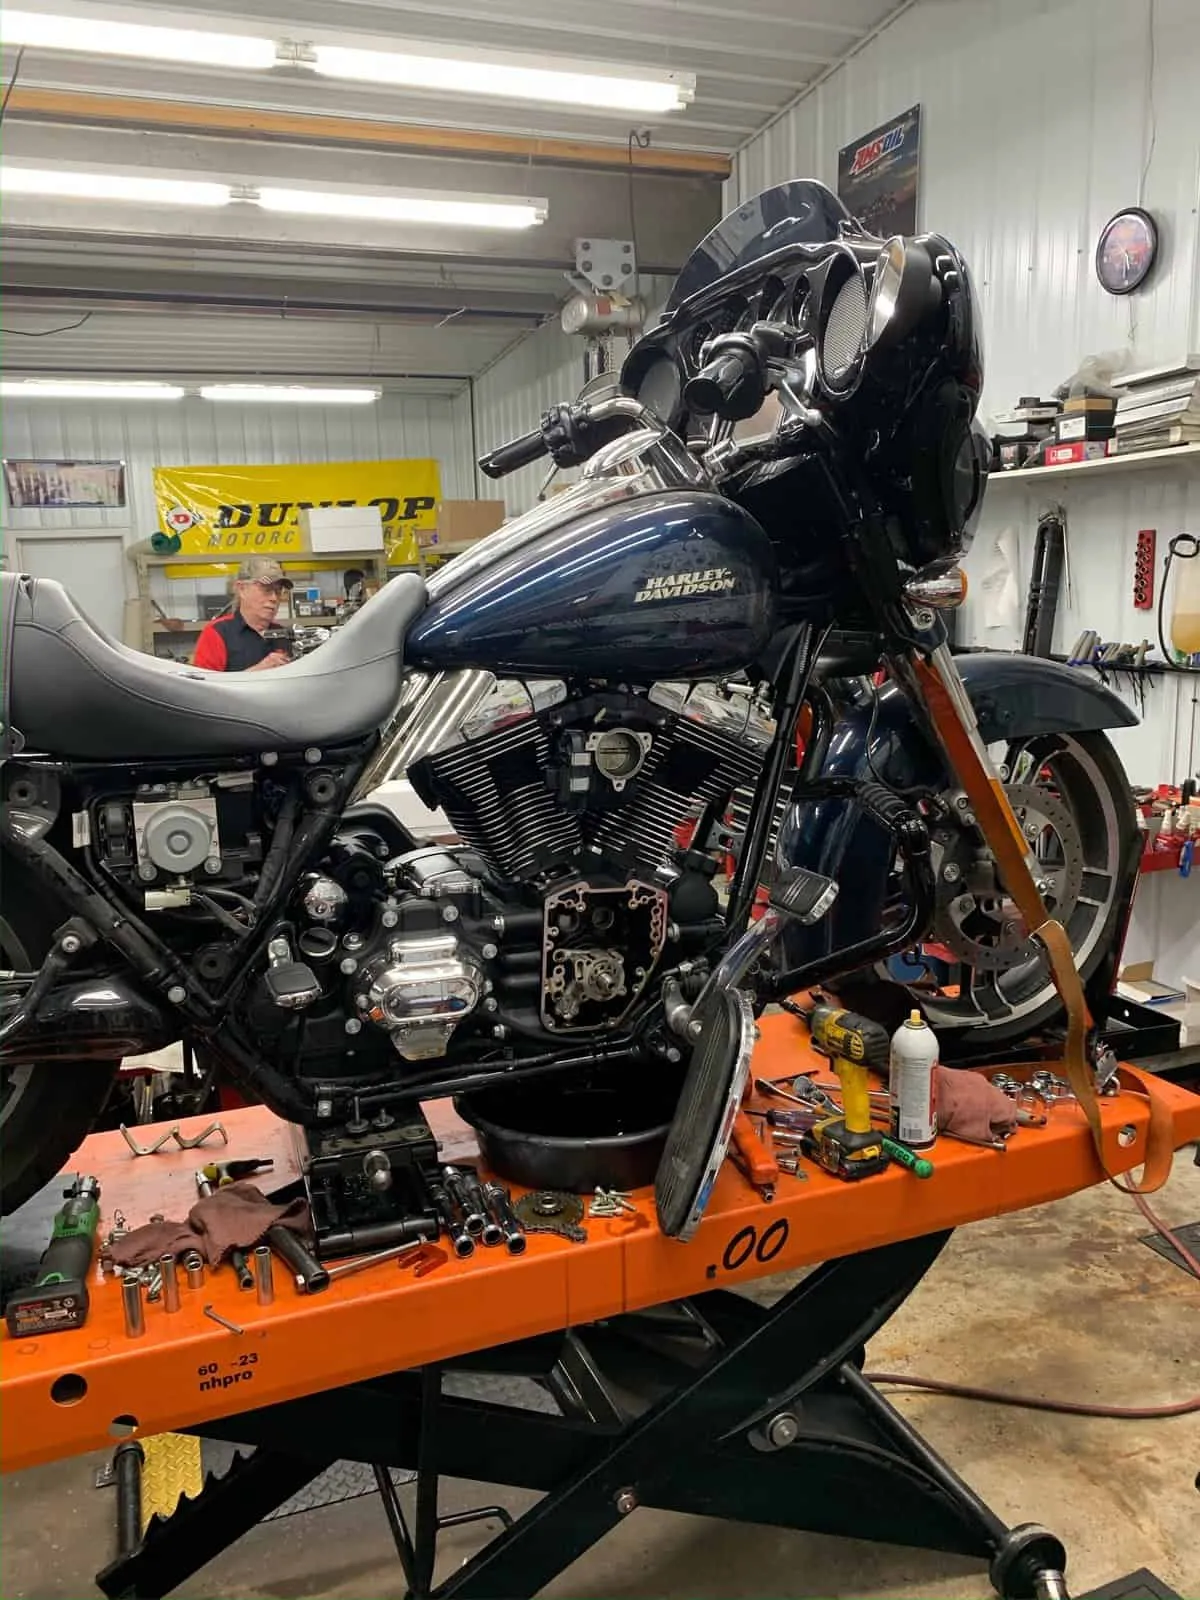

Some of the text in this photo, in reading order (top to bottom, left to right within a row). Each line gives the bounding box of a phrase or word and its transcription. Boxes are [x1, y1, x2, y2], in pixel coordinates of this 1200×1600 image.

[849, 124, 904, 175] AMSOIL
[213, 497, 435, 529] DUOP
[633, 577, 736, 603] DAVIDSON
[199, 1370, 253, 1391] nhpro
